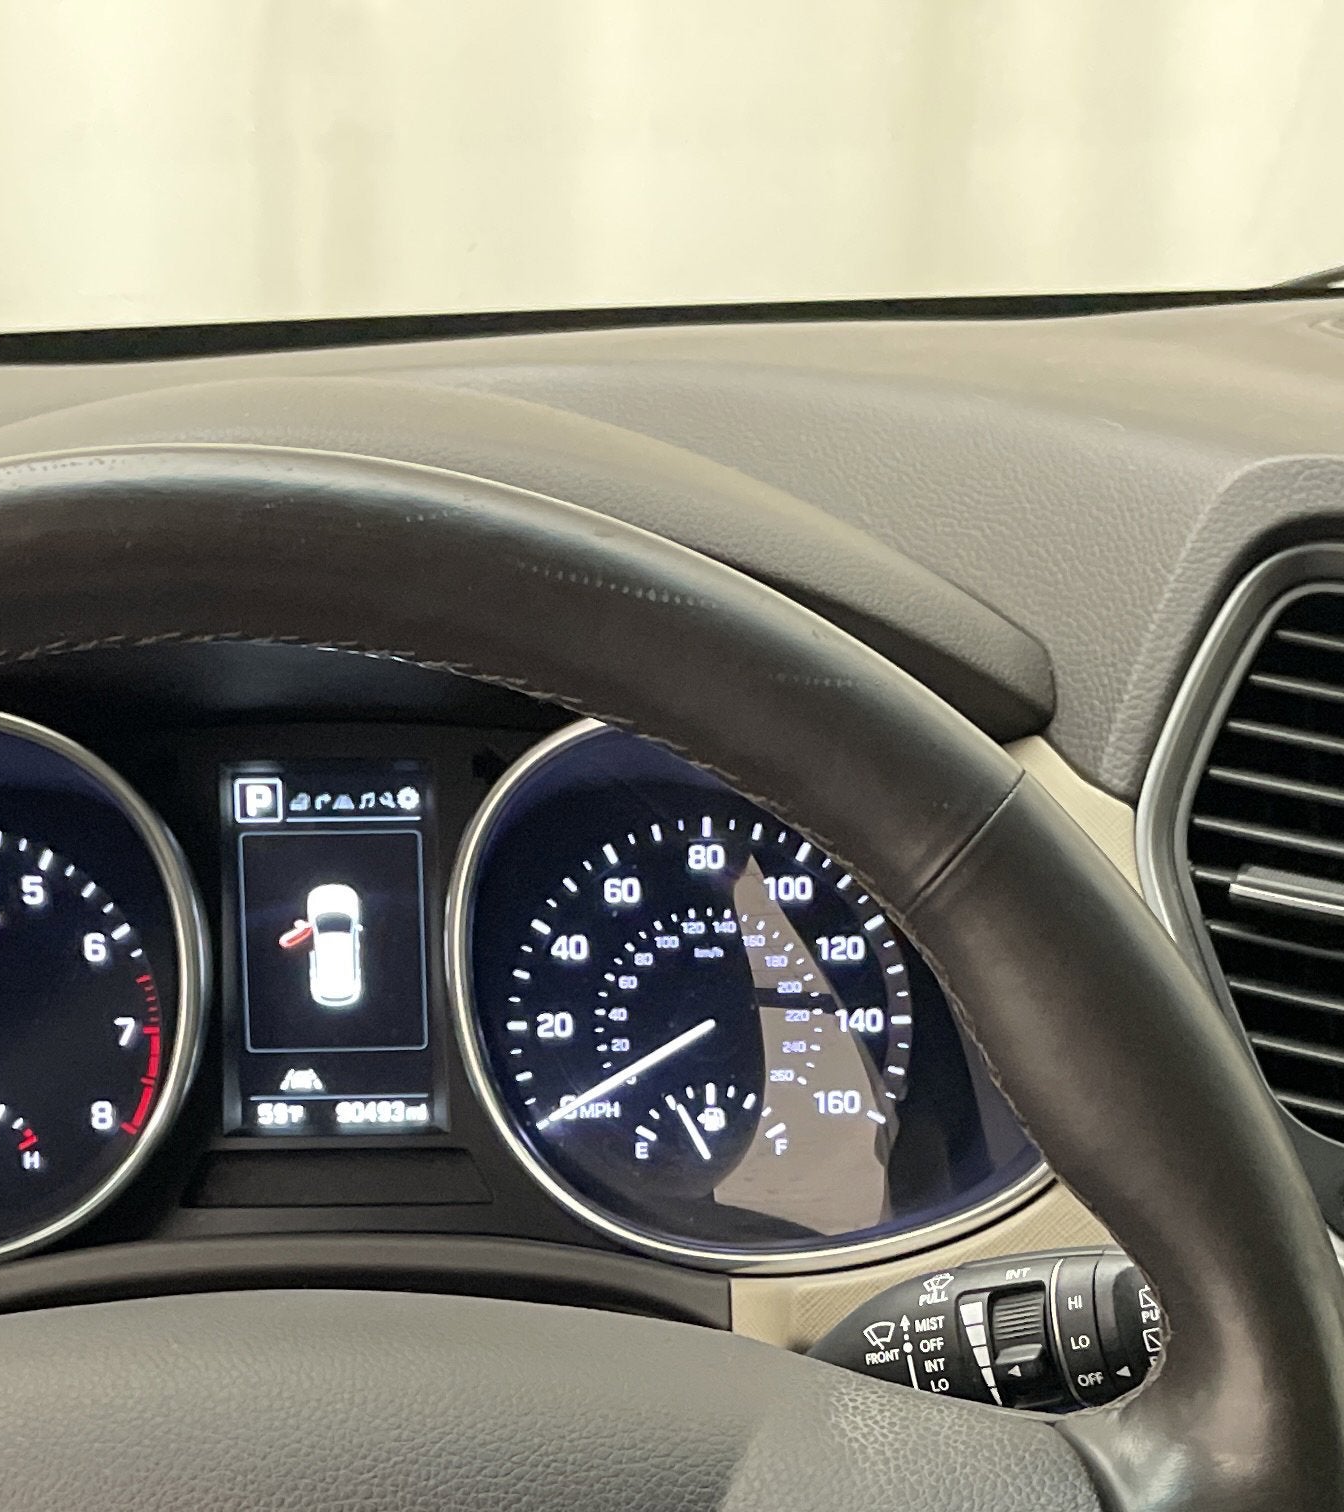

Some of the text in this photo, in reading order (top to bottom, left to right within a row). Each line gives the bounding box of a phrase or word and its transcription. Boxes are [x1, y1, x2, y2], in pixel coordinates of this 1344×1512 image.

[245, 784, 273, 817] P
[687, 844, 725, 870] 80
[21, 875, 45, 905] 5
[603, 877, 641, 905] 60
[763, 876, 814, 902] 100
[84, 932, 107, 962] 6
[550, 934, 589, 961] 40
[816, 935, 866, 963] 120
[113, 1017, 136, 1046] 7
[536, 1012, 574, 1039] 20
[834, 1007, 884, 1034] 140
[579, 1101, 620, 1119] MPH
[812, 1089, 862, 1116] 160
[90, 1101, 113, 1131] 8
[635, 1142, 649, 1160] E
[774, 1138, 789, 1156] F
[23, 1151, 40, 1169] H
[918, 1292, 949, 1306] PULL
[1067, 1296, 1083, 1310] HI
[915, 1316, 945, 1333] MIST
[919, 1338, 944, 1353] OFF
[1070, 1335, 1090, 1350] LO
[865, 1349, 900, 1366] FRONT
[924, 1358, 945, 1373] INT
[930, 1378, 950, 1393] LO
[1077, 1372, 1105, 1388] OFF
